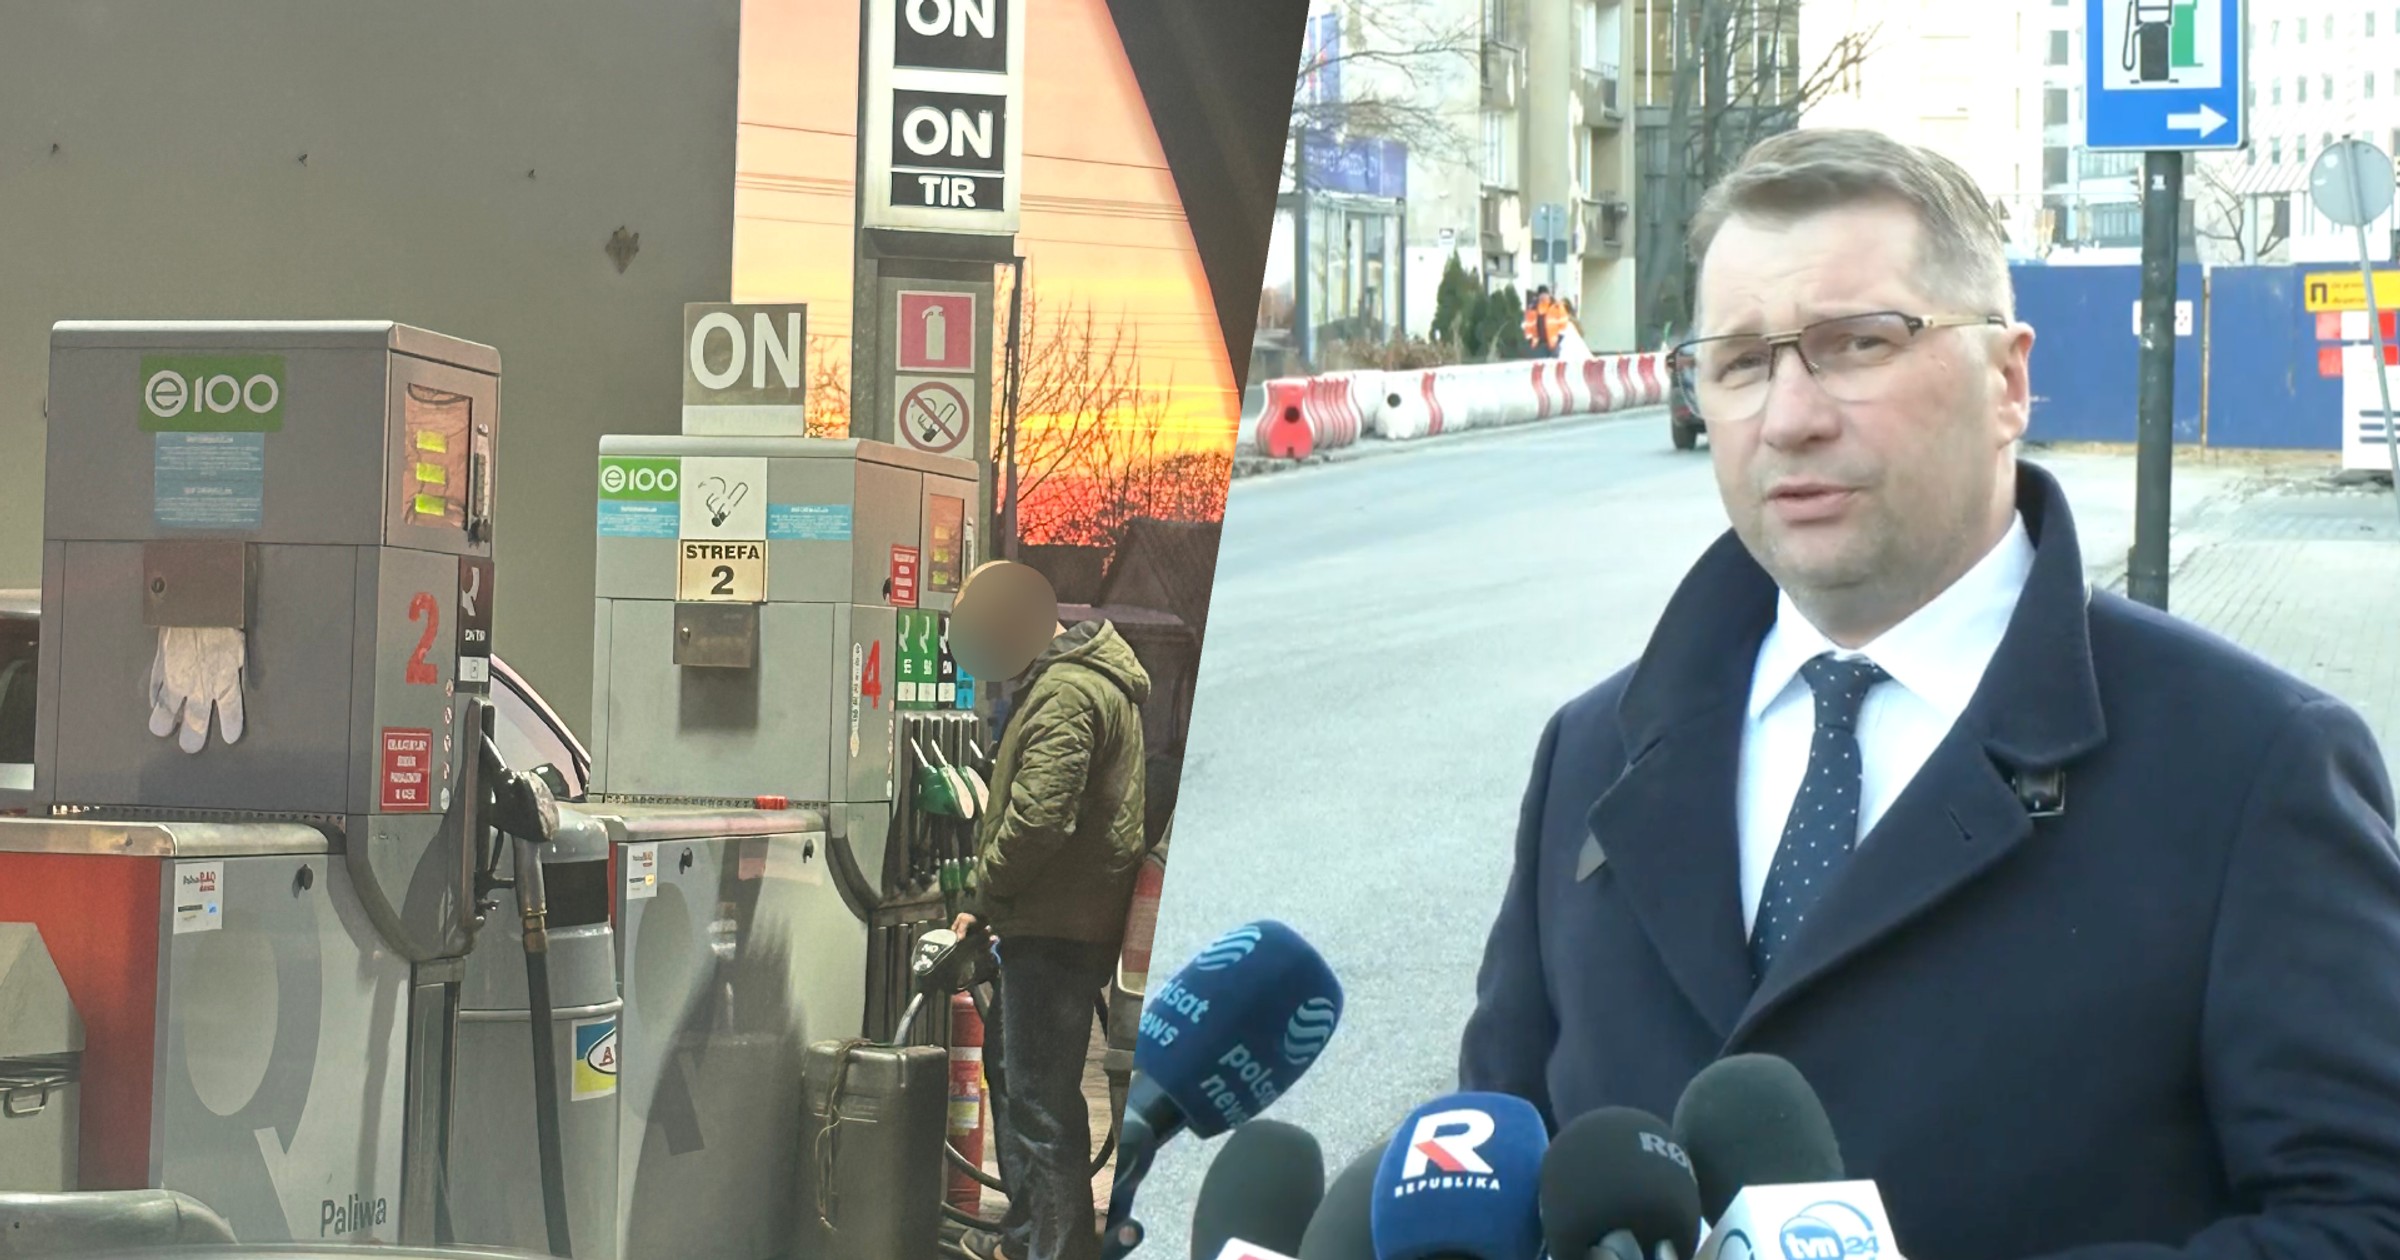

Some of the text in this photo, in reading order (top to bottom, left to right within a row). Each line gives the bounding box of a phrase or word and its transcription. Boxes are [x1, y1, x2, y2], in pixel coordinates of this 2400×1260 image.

[904, 0, 995, 38] ON
[902, 105, 993, 158] ON
[918, 175, 976, 208] TIR
[690, 312, 801, 389] ON
[686, 545, 760, 560] STREFA
[710, 565, 734, 596] 2
[405, 591, 440, 685] 2
[862, 640, 882, 711] 4
[1138, 1010, 1180, 1048] ews
[1394, 1176, 1500, 1198] REPUBLIKA
[321, 1193, 387, 1238] Paliwa
